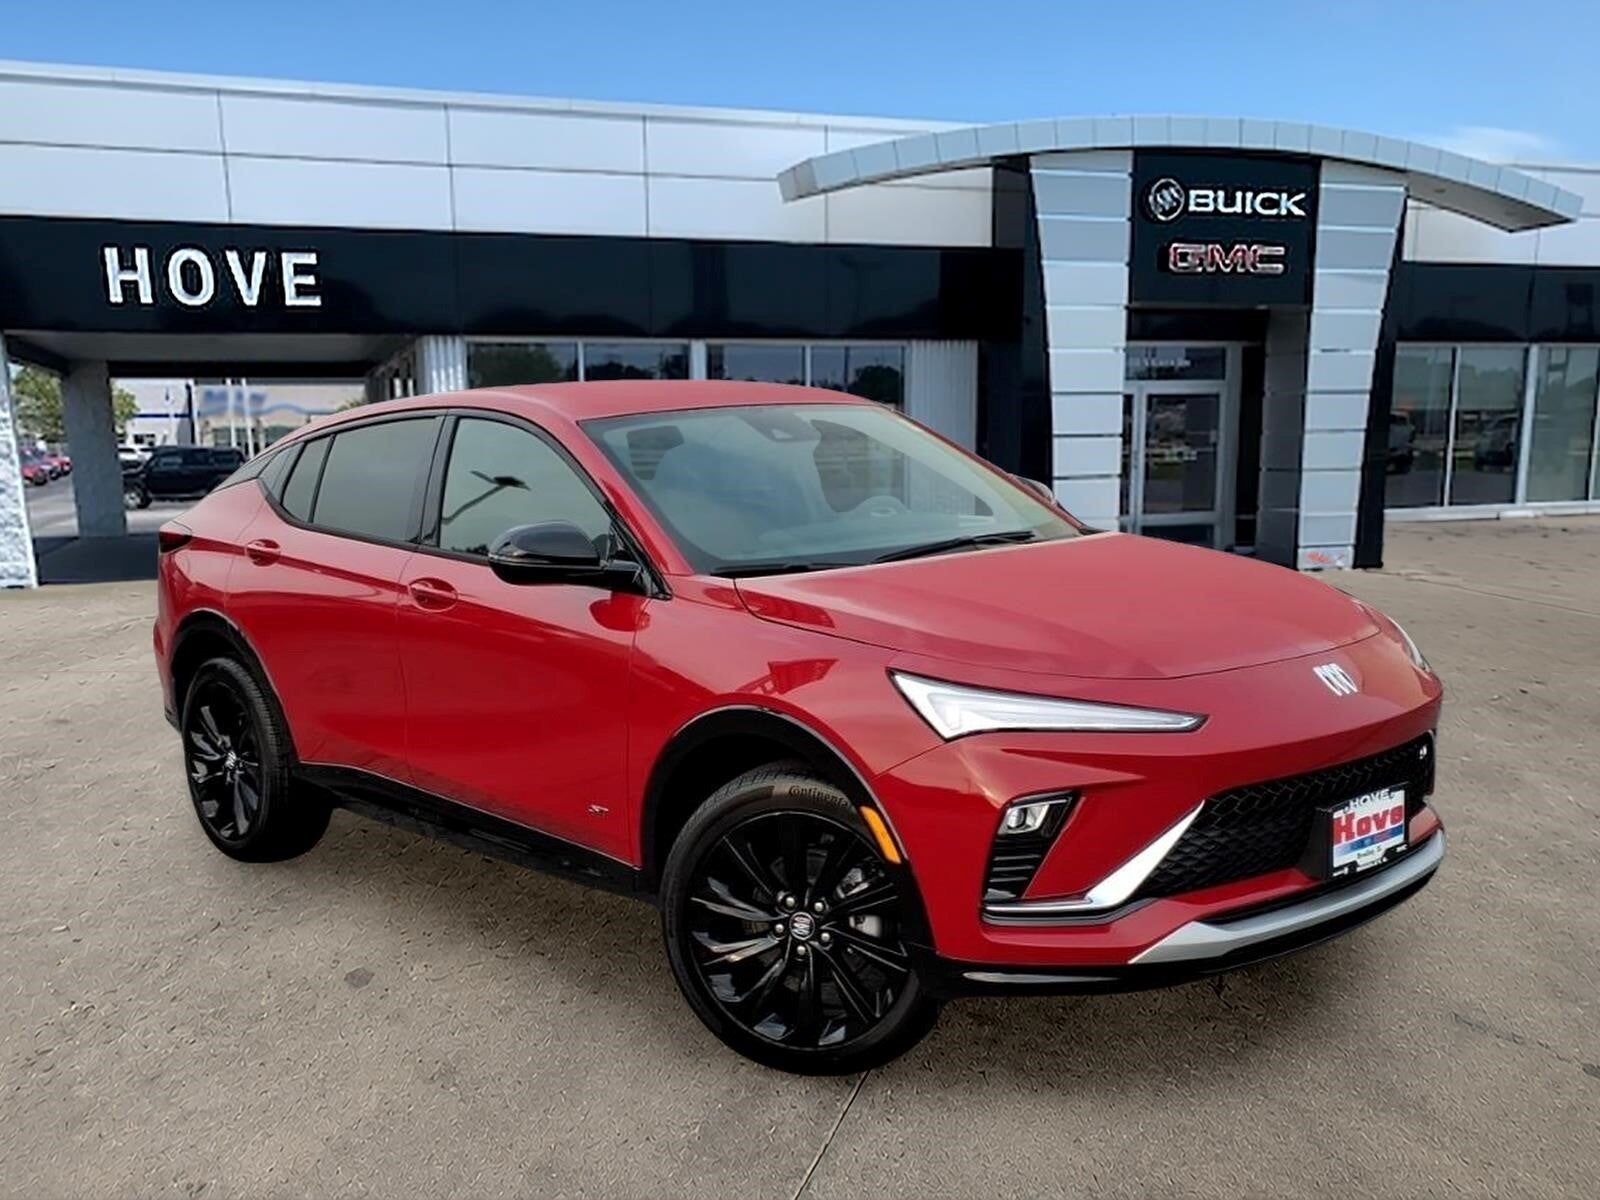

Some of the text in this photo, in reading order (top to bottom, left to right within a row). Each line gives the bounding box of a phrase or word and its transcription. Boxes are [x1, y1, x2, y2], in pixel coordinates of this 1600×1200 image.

[1188, 189, 1306, 216] BUICK
[1168, 242, 1286, 275] GMC
[103, 247, 322, 306] HOVE
[788, 785, 850, 807] Continenta
[1349, 788, 1390, 809] HOVE
[1333, 805, 1404, 845] Hove
